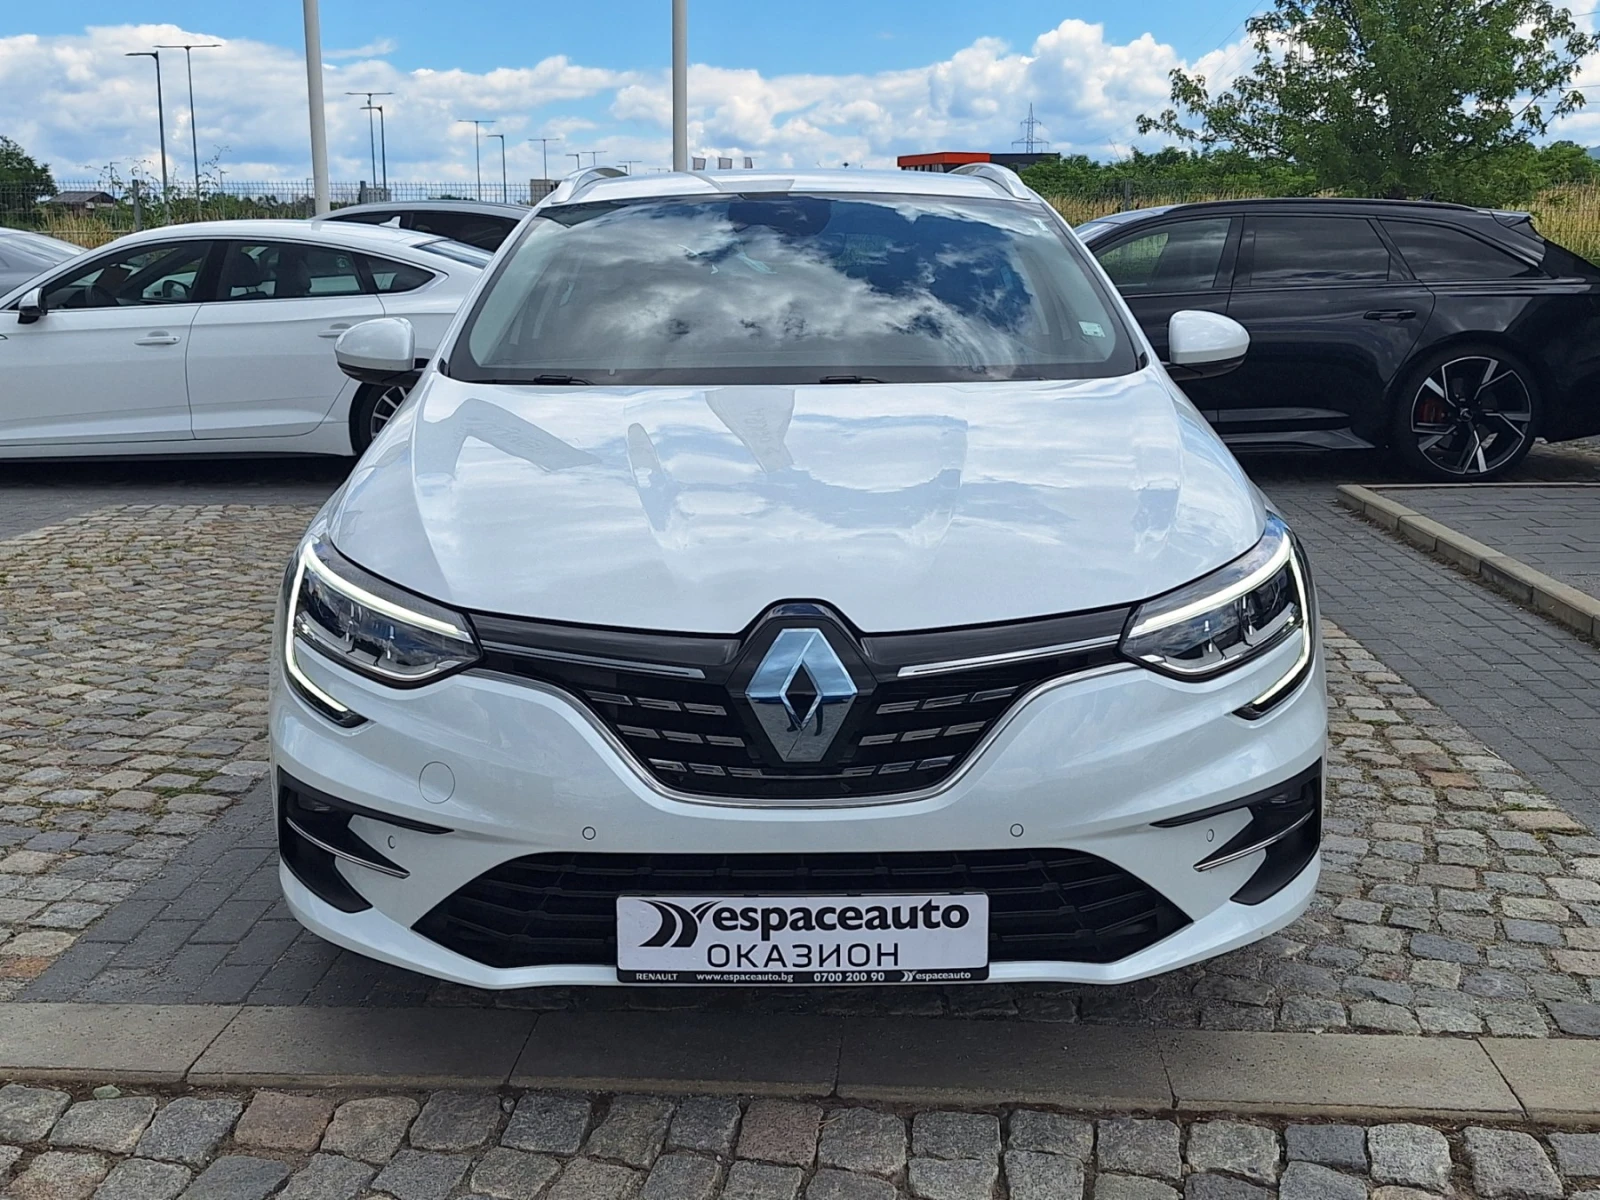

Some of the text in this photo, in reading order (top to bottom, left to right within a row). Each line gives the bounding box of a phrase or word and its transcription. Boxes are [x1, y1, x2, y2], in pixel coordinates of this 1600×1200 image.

[712, 898, 970, 941] espaceauto
[707, 943, 899, 968] ОКАЗИОН
[636, 970, 971, 982] RENAULT www.espaceauto.bg 0700 200 90 espaceauto
